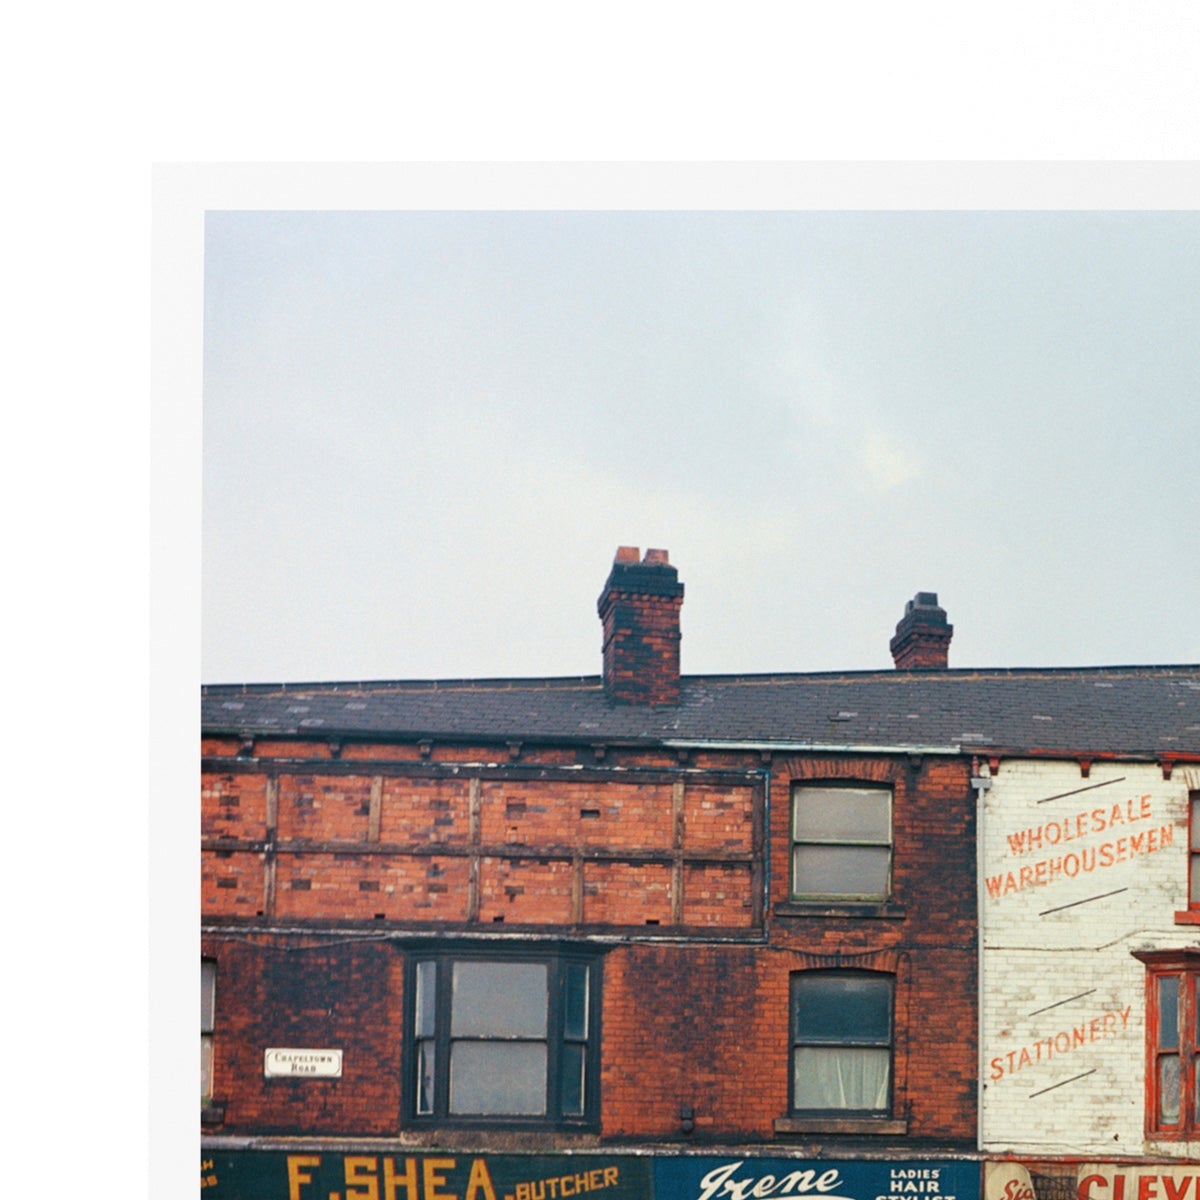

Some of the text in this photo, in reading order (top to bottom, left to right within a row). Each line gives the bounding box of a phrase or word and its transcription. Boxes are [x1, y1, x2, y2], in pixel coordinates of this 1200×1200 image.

[1006, 794, 1152, 857] WHOLESALE
[985, 824, 1174, 899] WAREHOUSEMEN
[290, 1063, 317, 1073] ROAD
[990, 1006, 1131, 1081] STATIONERY
[890, 1181, 940, 1194] HAIR
